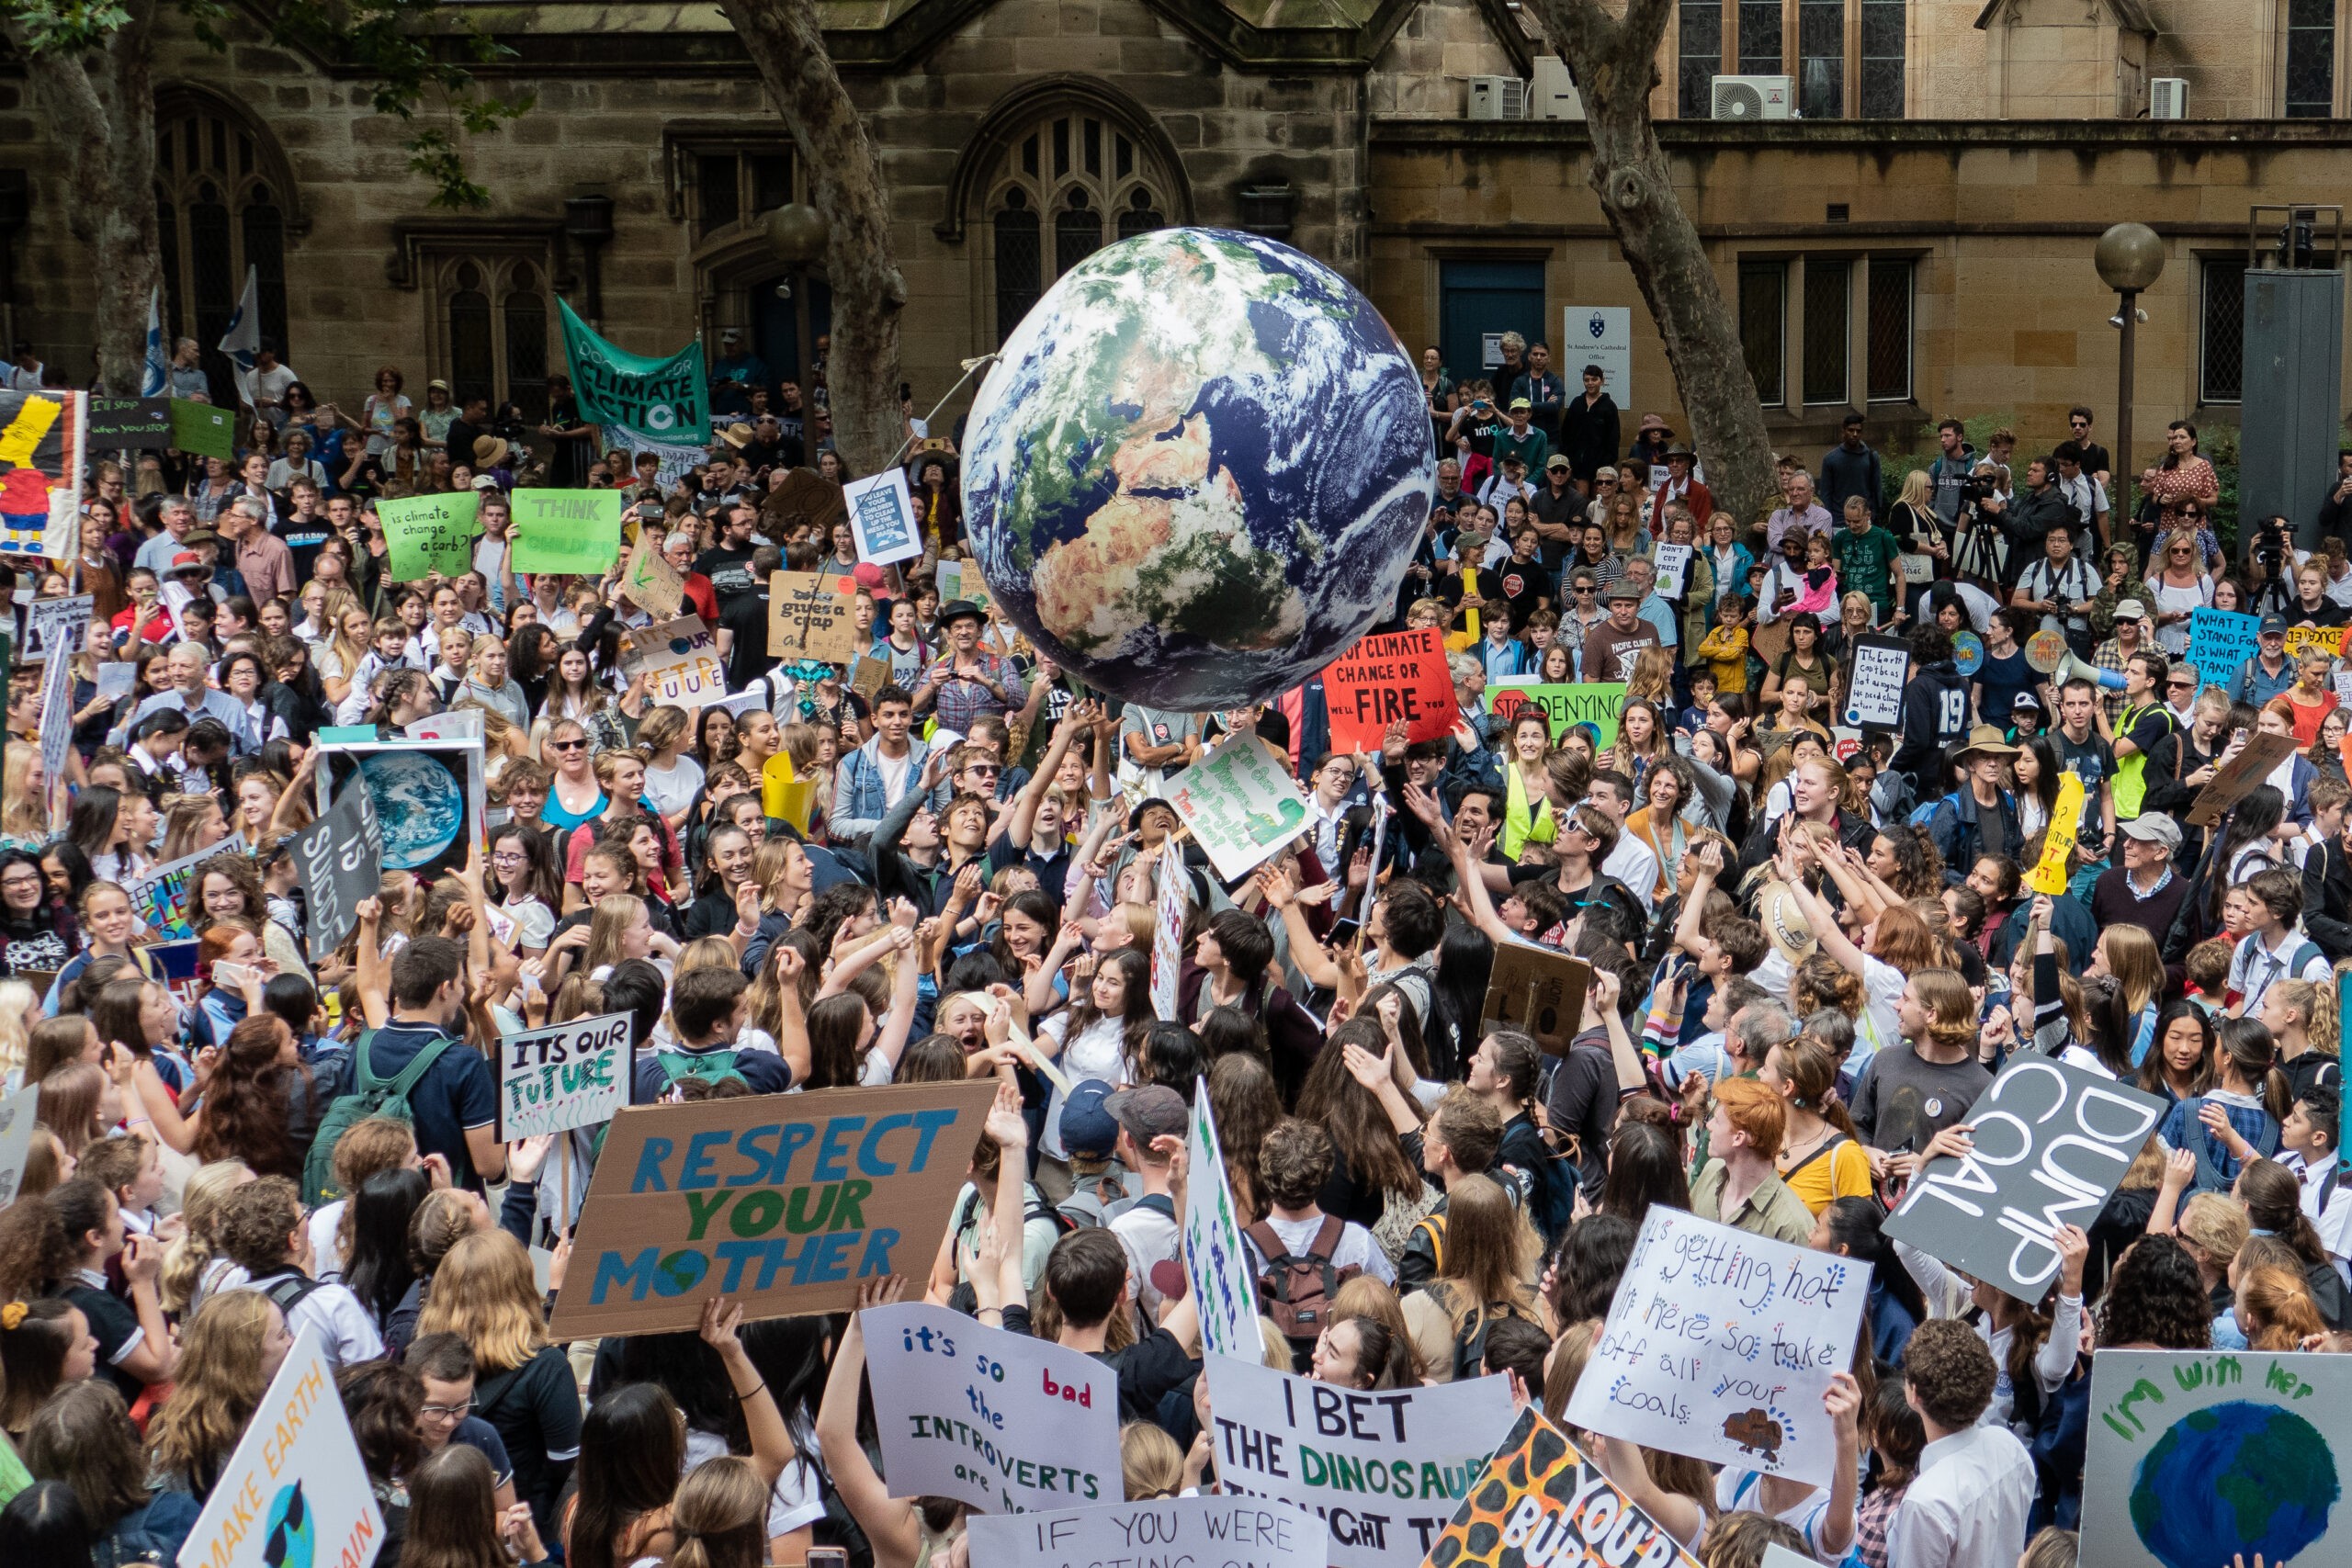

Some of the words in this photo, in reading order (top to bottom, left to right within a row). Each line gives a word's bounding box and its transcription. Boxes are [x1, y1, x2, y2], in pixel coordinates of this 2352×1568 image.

[580, 359, 694, 401] CLIMATE
[584, 385, 696, 430] ACTION
[863, 502, 894, 515] CHILDREN
[867, 498, 887, 507] YOUR
[873, 488, 893, 500] LEAVE
[392, 512, 402, 524] is
[405, 505, 450, 524] climate
[403, 523, 447, 540] change
[865, 513, 874, 522] TO
[876, 507, 896, 518] CLEAN
[866, 525, 885, 534] MESS
[886, 520, 900, 528] YOU
[881, 515, 892, 524] THE
[421, 541, 429, 551] a
[432, 535, 469, 551] carb?
[1661, 545, 1683, 553] DON'T
[1657, 563, 1679, 571] TREES
[794, 615, 833, 632] crap
[833, 605, 845, 615] a
[2196, 613, 2234, 628] WHAT
[2242, 620, 2249, 631] I
[1367, 632, 1433, 658] CLIMATE
[1611, 640, 1633, 655] PACIFIC
[1633, 637, 1653, 649] CLIMATE
[1860, 649, 1876, 662] The
[1877, 650, 1903, 664] Earth
[2195, 645, 2207, 658] IS
[2209, 647, 2240, 661] WHAT
[2197, 629, 2235, 644] STAND
[2239, 635, 2260, 648] FOR
[1336, 663, 1396, 683] CHANGE
[1399, 661, 1420, 680] OR
[1854, 672, 1870, 685] hot
[2192, 659, 2235, 675] STAND
[1330, 705, 1354, 716] WE'LL
[1354, 687, 1422, 726] FIRE
[1424, 700, 1445, 710] YOU
[1939, 689, 1965, 733] 19
[338, 835, 368, 873] IS
[127, 881, 160, 912] EEP
[302, 825, 346, 956] SUICIDE
[511, 1032, 569, 1070] IT'S
[575, 1020, 628, 1055] OUR
[503, 1048, 617, 1113] FUTURE
[629, 1108, 960, 1195] RESPECT
[1898, 1062, 2069, 1218] COAL
[1996, 1086, 2158, 1286] DUMP
[685, 1179, 873, 1242] YOUR
[589, 1227, 901, 1306] MOTHER
[1663, 1233, 1774, 1310] getting
[1781, 1258, 1840, 1309] hot
[1721, 1325, 1757, 1358] so
[1770, 1325, 1834, 1368] take
[903, 1325, 956, 1358] it's
[976, 1354, 1005, 1383] so
[1043, 1367, 1091, 1410] bad
[1602, 1331, 1647, 1366] off
[1659, 1356, 1696, 1382] all
[1718, 1374, 1786, 1405] your
[966, 1384, 1004, 1431] the
[1283, 1377, 1296, 1429] I
[1311, 1384, 1414, 1444] BET
[2101, 1377, 2166, 1443] I'm
[2172, 1354, 2243, 1393] with
[2266, 1359, 2314, 1400] her
[197, 1470, 265, 1568] MAKE
[262, 1359, 325, 1481] EARTH
[909, 1414, 1100, 1500] INTROVERTS
[1214, 1416, 1290, 1480] THE
[1298, 1443, 1495, 1501] DINOSAUR
[953, 1463, 990, 1493] are
[1001, 1486, 1040, 1516] he
[1036, 1517, 1082, 1553] IF
[1109, 1510, 1179, 1549] YOU
[1204, 1508, 1295, 1553] WERE
[1557, 1461, 1688, 1568] YOU'R
[332, 1506, 376, 1568] AIN
